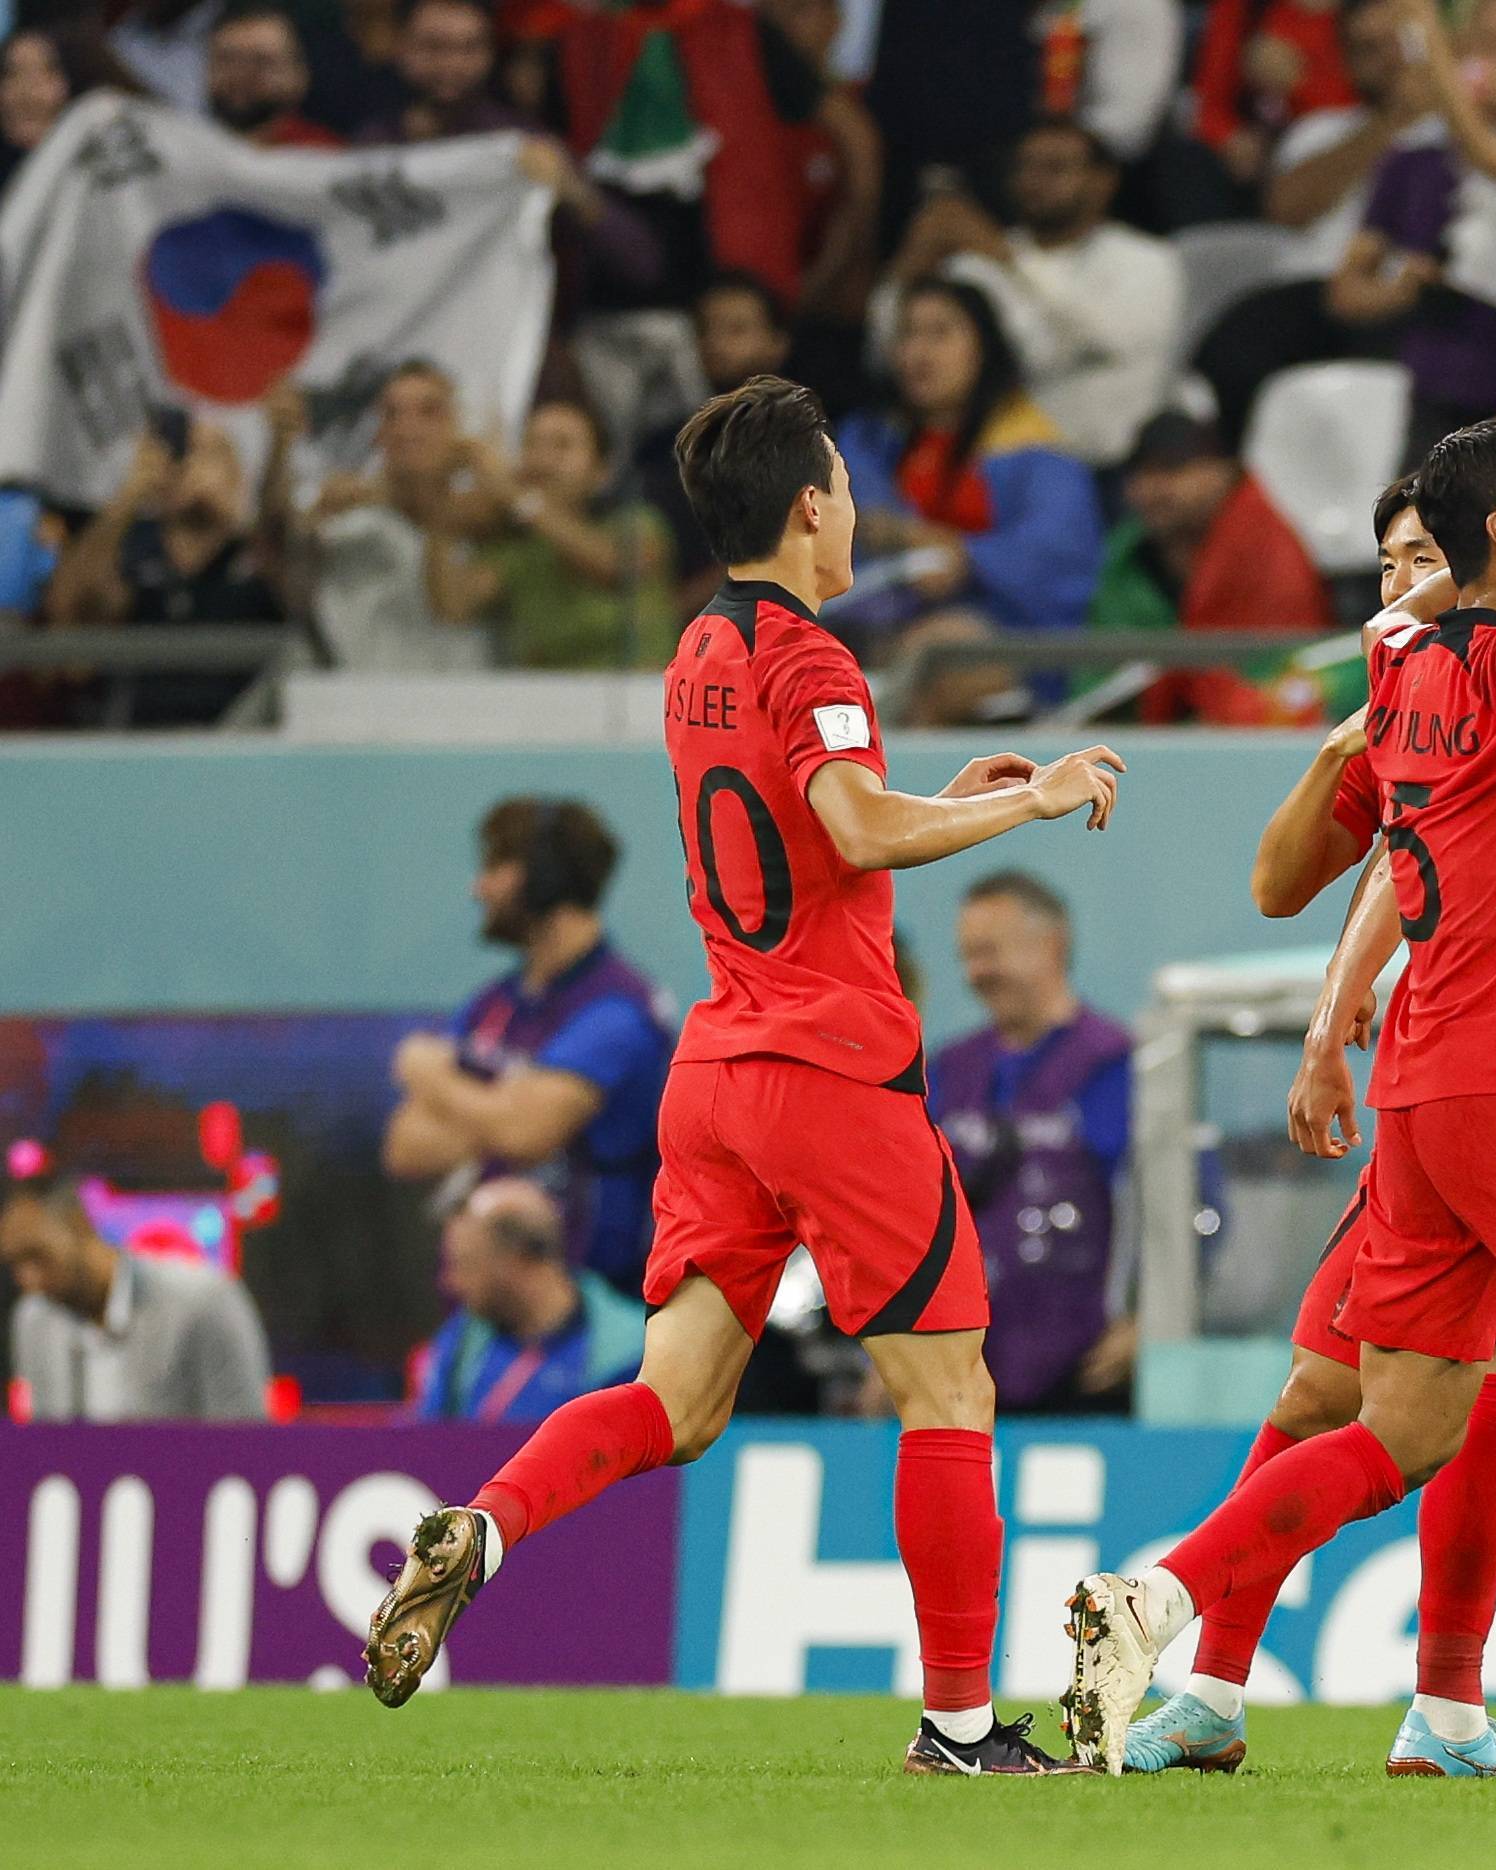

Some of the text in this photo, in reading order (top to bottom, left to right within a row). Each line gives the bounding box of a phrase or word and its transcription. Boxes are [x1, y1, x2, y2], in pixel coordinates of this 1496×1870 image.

[675, 678, 686, 722] S
[687, 682, 737, 730] LEE
[673, 764, 795, 953] 0
[1388, 782, 1443, 943] 5
